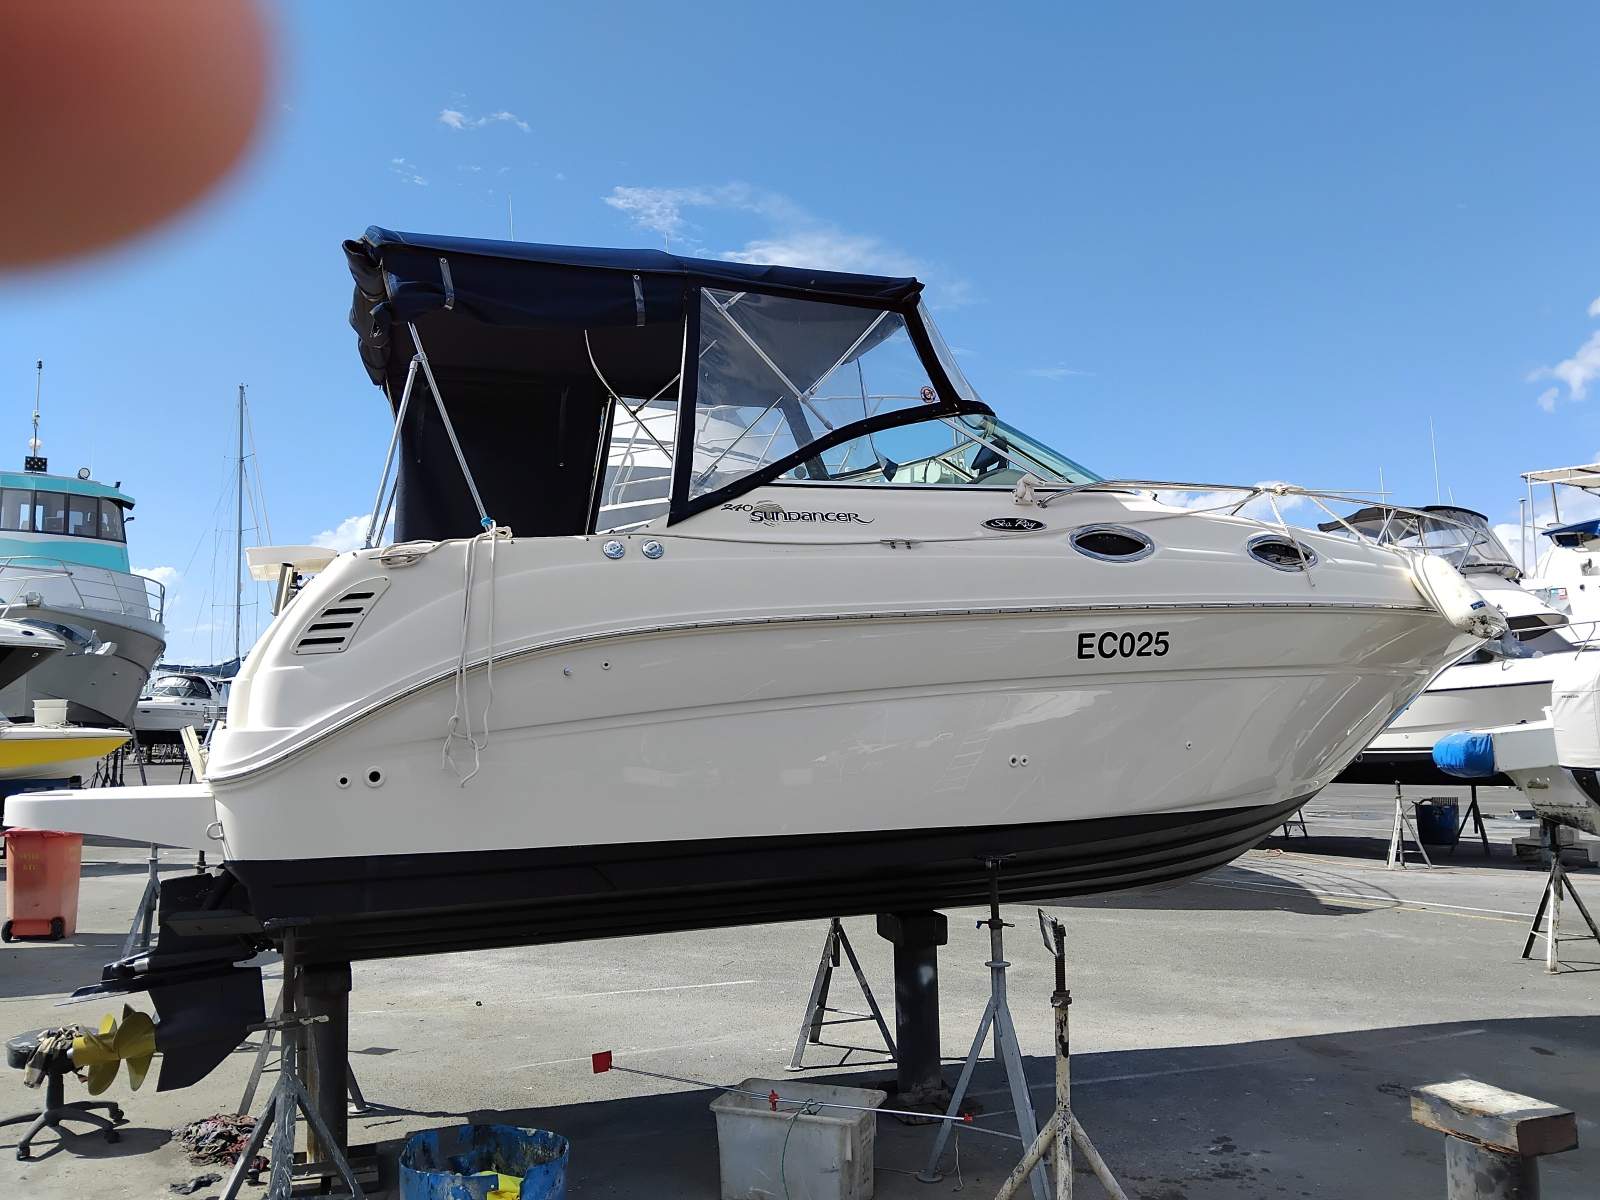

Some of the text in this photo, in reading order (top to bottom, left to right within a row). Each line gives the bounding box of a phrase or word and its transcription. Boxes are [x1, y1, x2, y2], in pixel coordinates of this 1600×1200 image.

[720, 503, 754, 512] 240
[991, 519, 1037, 530] Sea Ray
[1077, 631, 1170, 659] EC025
